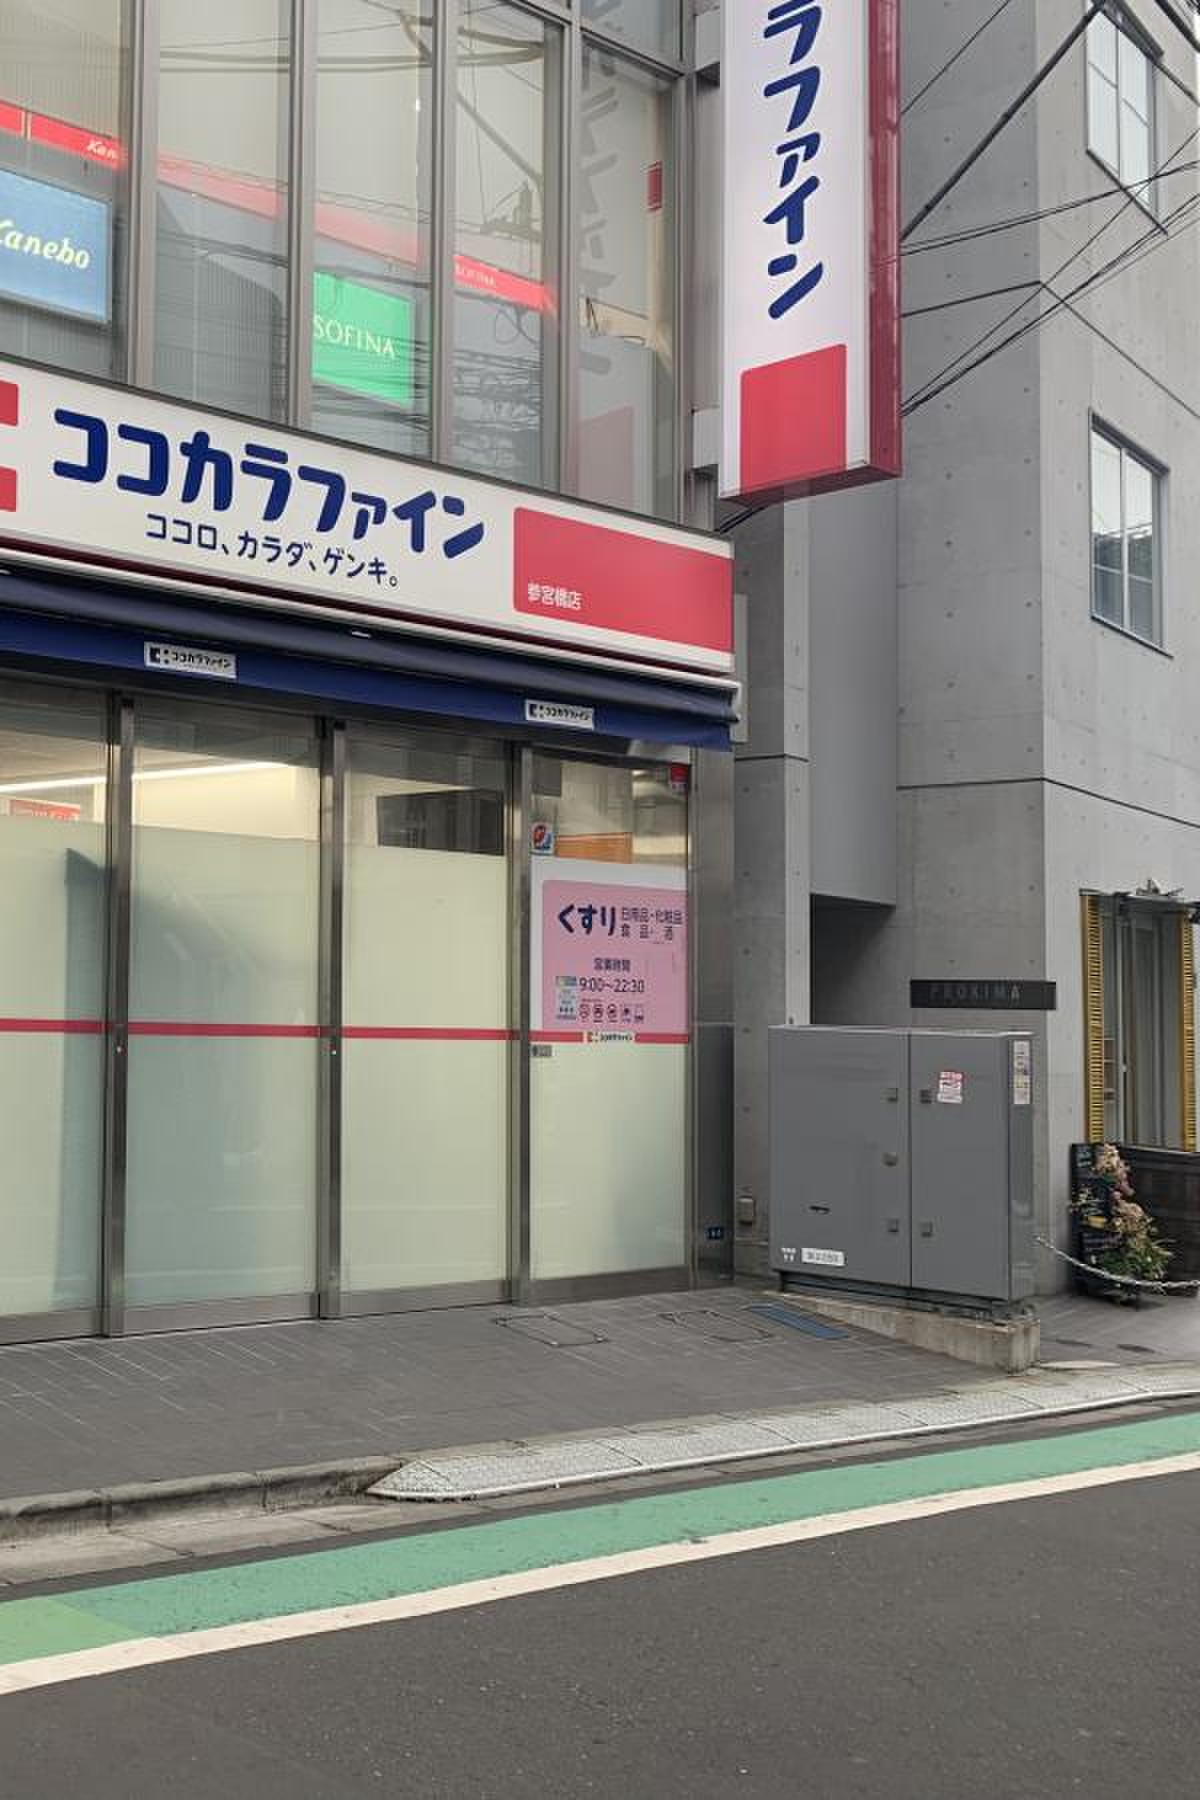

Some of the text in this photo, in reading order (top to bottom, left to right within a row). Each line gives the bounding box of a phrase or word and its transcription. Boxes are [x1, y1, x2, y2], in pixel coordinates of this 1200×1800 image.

[313, 315, 395, 359] SOFINA
[53, 408, 484, 558] ココカラファイン
[558, 904, 616, 936] くすり
